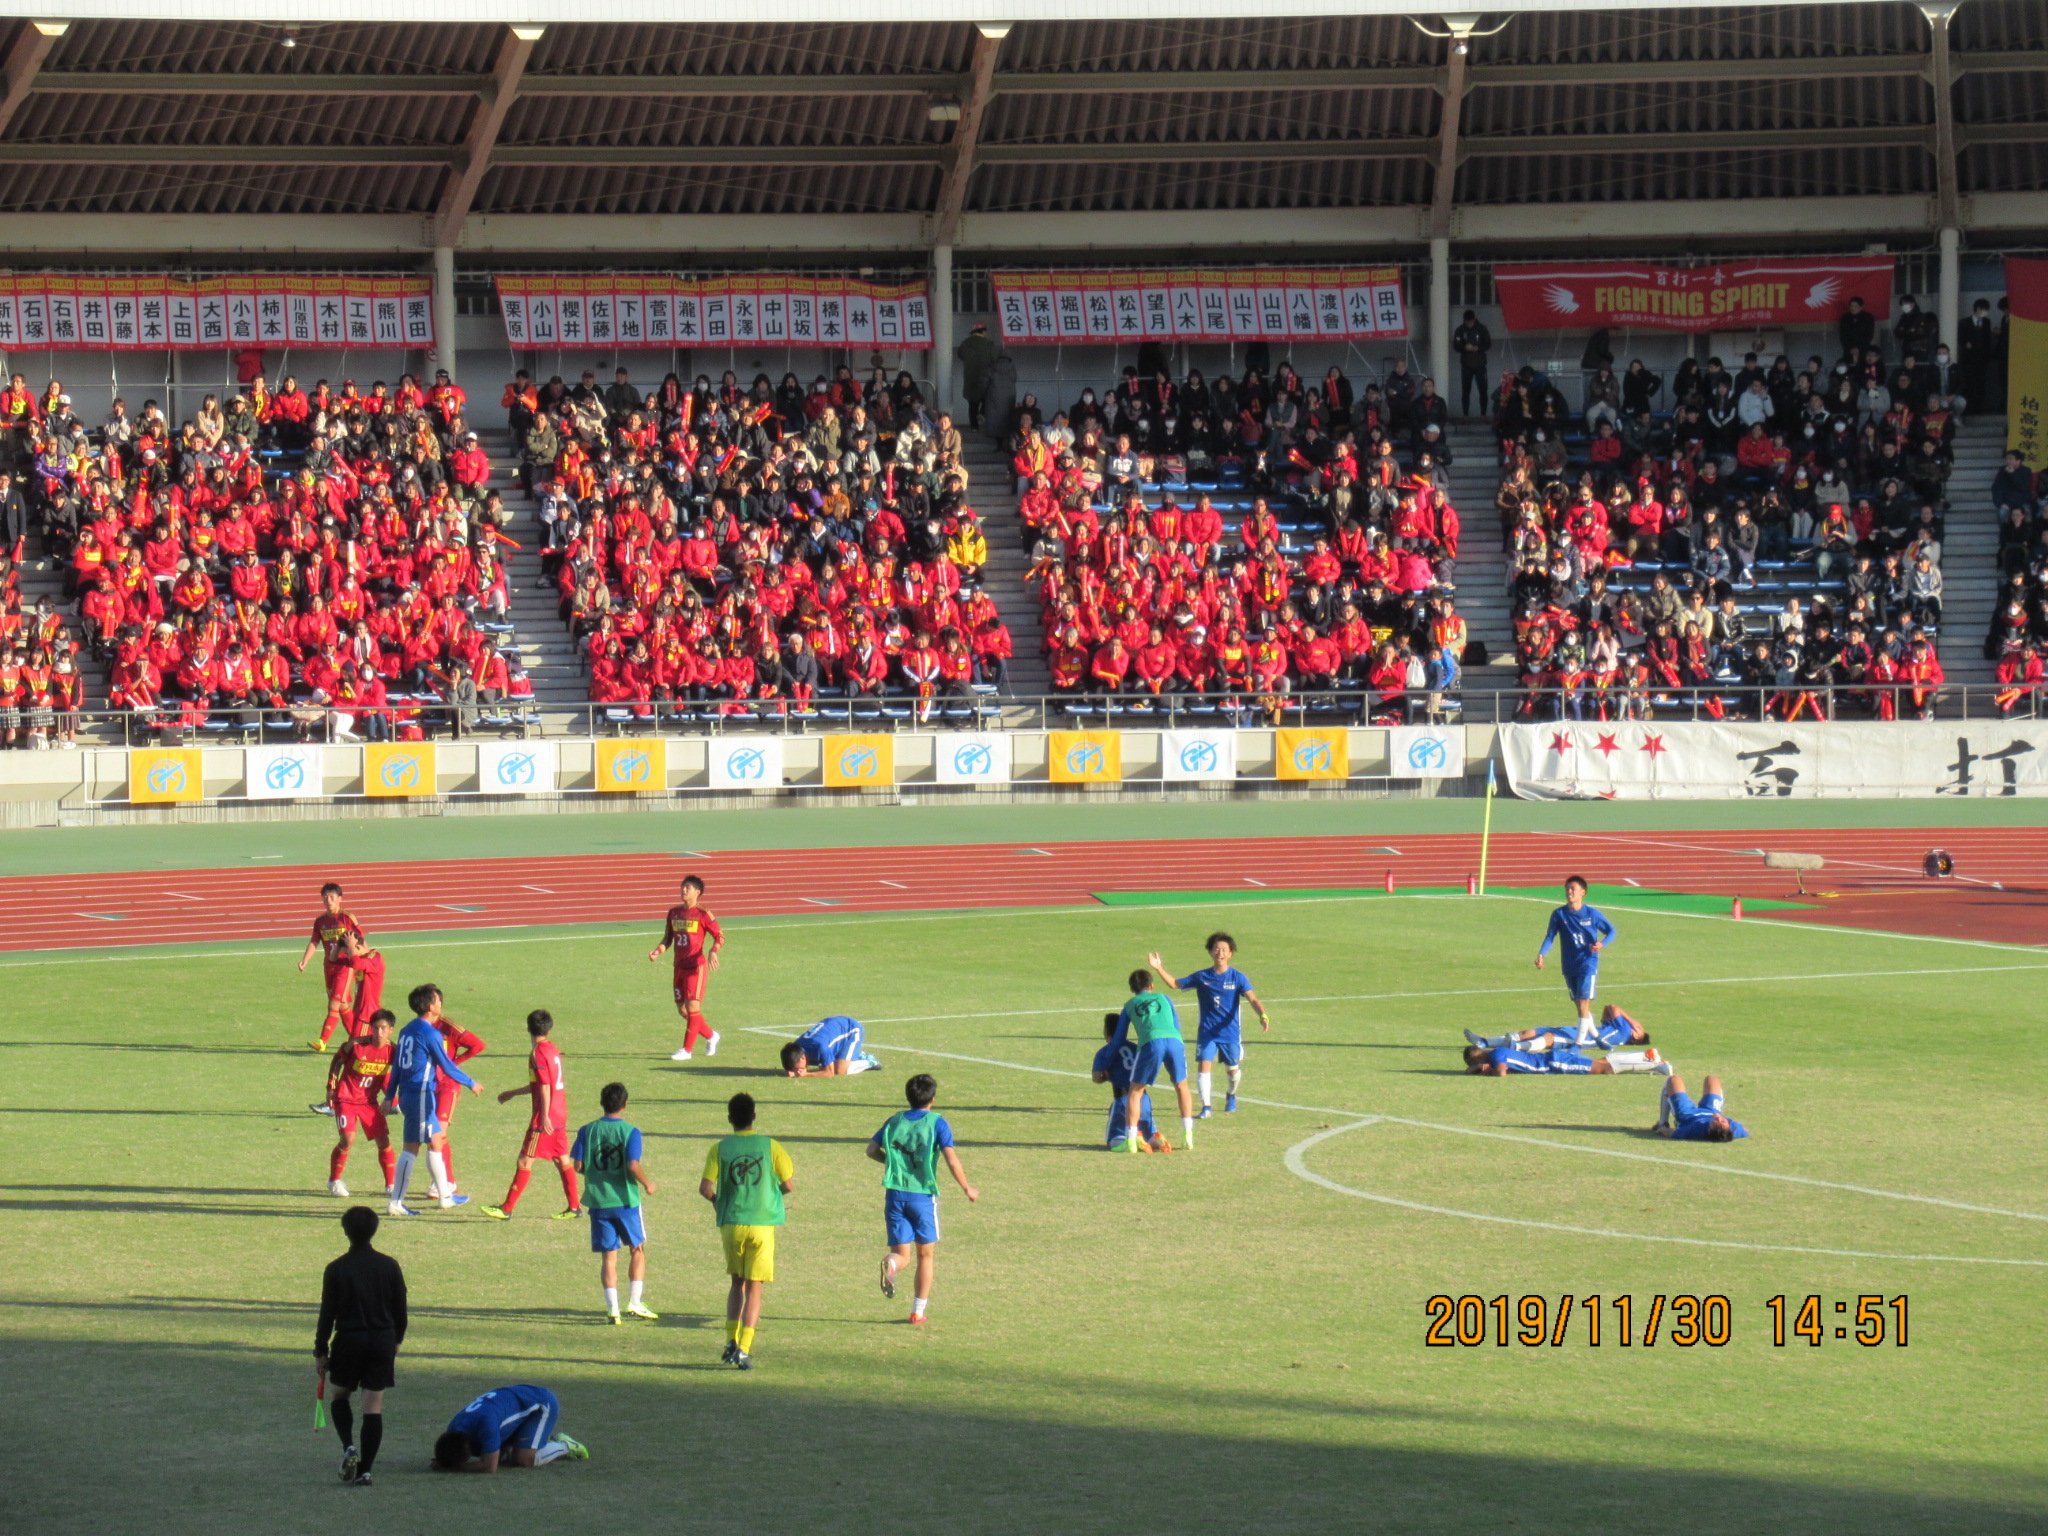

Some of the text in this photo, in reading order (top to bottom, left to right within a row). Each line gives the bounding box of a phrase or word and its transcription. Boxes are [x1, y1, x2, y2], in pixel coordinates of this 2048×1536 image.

[262, 299, 281, 336] 柿本
[649, 300, 668, 336] 菅原
[707, 300, 725, 336] 戸田
[765, 299, 782, 335] 中山
[793, 299, 811, 337] 羽坂
[1003, 296, 1023, 332] 古谷
[1032, 295, 1052, 332] 保科
[1061, 296, 1080, 330] 堀田
[1090, 295, 1109, 331] 松村
[1119, 295, 1138, 330] 松本
[1147, 294, 1165, 330] 望月
[1177, 292, 1196, 329] 八木
[1205, 293, 1225, 329] 山尾
[1234, 293, 1252, 330] 山下
[1263, 293, 1282, 329] 山田
[1349, 292, 1369, 328] 小林
[1378, 291, 1397, 326] 田中
[1594, 283, 1790, 317] FIGHTING SPIRIT
[22, 300, 44, 338] 石塚
[53, 300, 74, 338] 石橋
[83, 301, 104, 338] 井田
[114, 301, 133, 340] 伊藤
[143, 301, 162, 338] 岩本
[173, 301, 192, 338] 上田
[203, 301, 222, 338] 大西
[233, 300, 251, 337] 小倉
[294, 299, 308, 339] 川原田
[320, 301, 339, 338] 木村
[350, 302, 368, 338] 工藤
[408, 301, 426, 337] 栗田
[505, 300, 524, 338] 栗原
[533, 301, 552, 338] 小山
[591, 300, 610, 338] 佐藤
[620, 301, 640, 337] 下地
[822, 301, 840, 337] 橋本
[851, 310, 869, 327] 林
[908, 301, 926, 337] 福田
[676, 934, 688, 946] 23
[398, 1034, 414, 1070] 13
[1118, 1046, 1135, 1071] 8
[359, 1075, 373, 1089] 10
